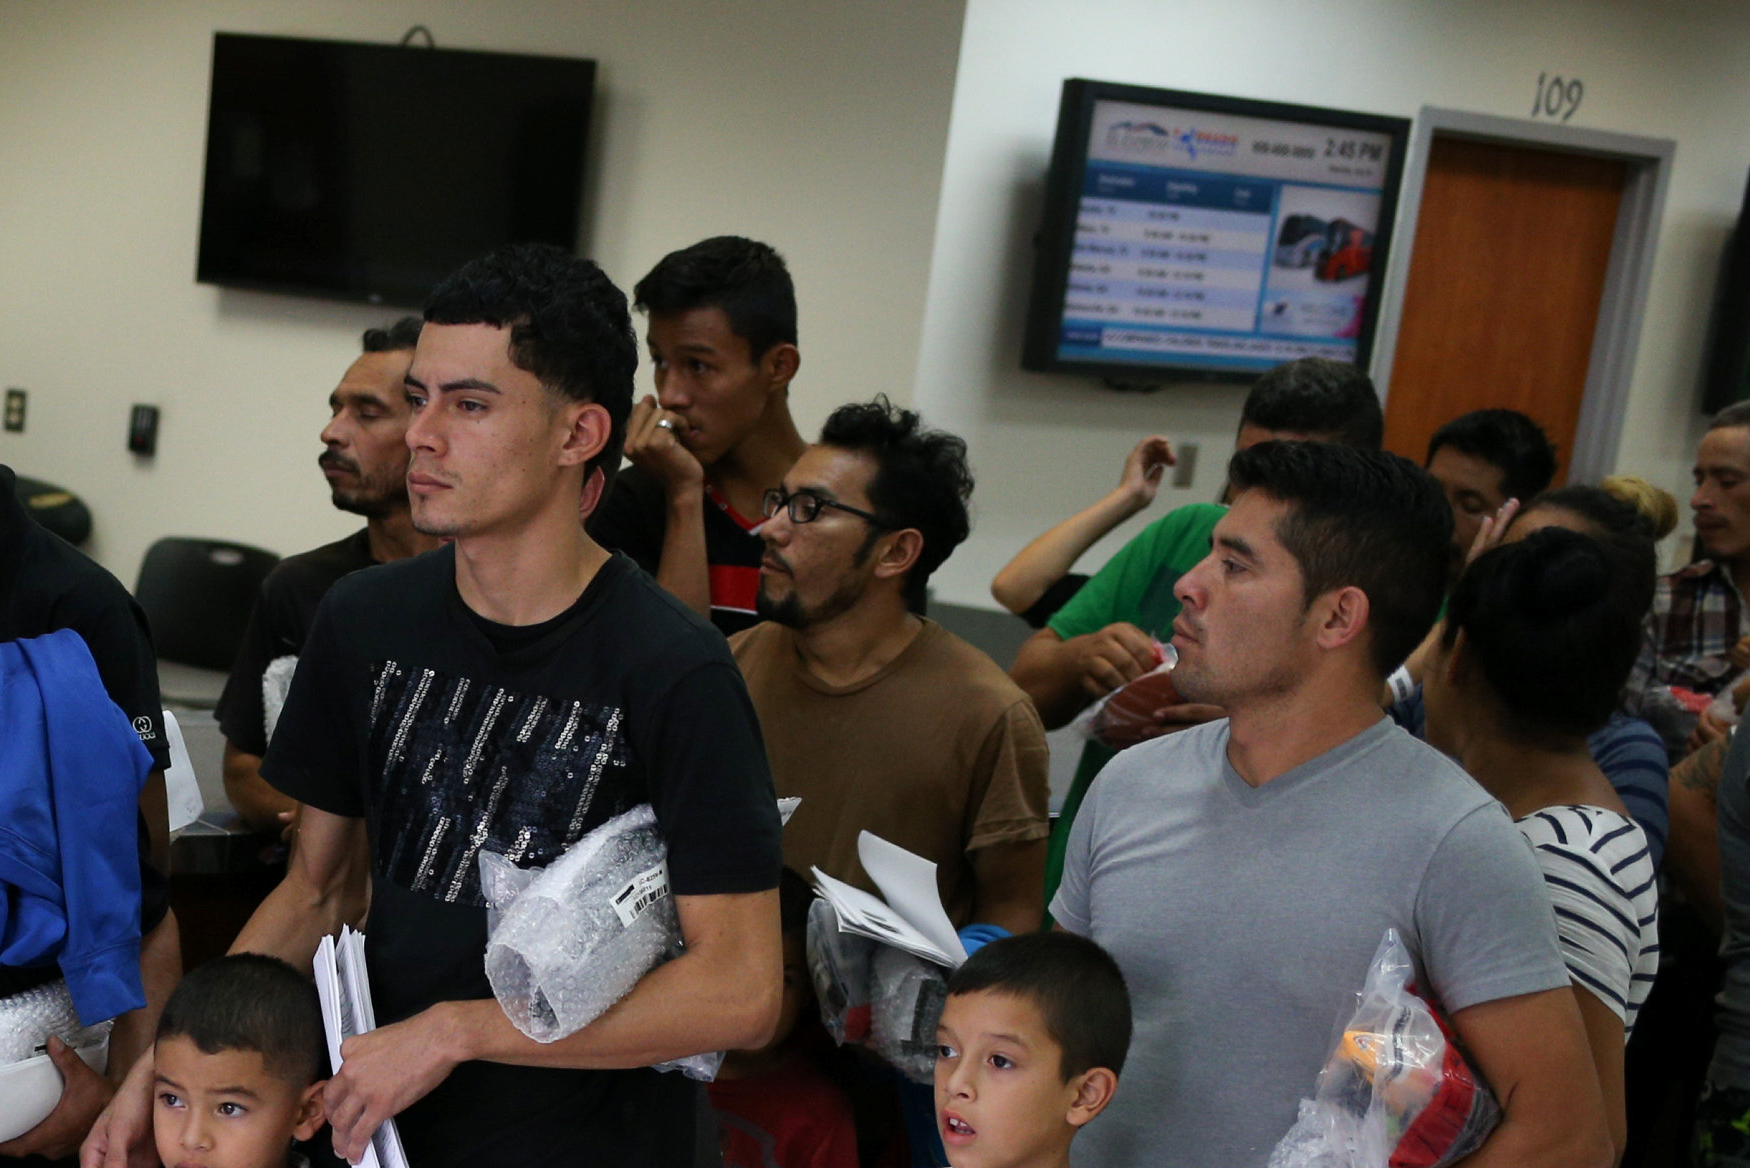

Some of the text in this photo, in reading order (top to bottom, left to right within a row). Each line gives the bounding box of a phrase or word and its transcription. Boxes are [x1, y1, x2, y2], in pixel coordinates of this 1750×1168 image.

[1532, 71, 1583, 121] 109
[1359, 142, 1383, 161] PM
[139, 732, 156, 740] UCCI
